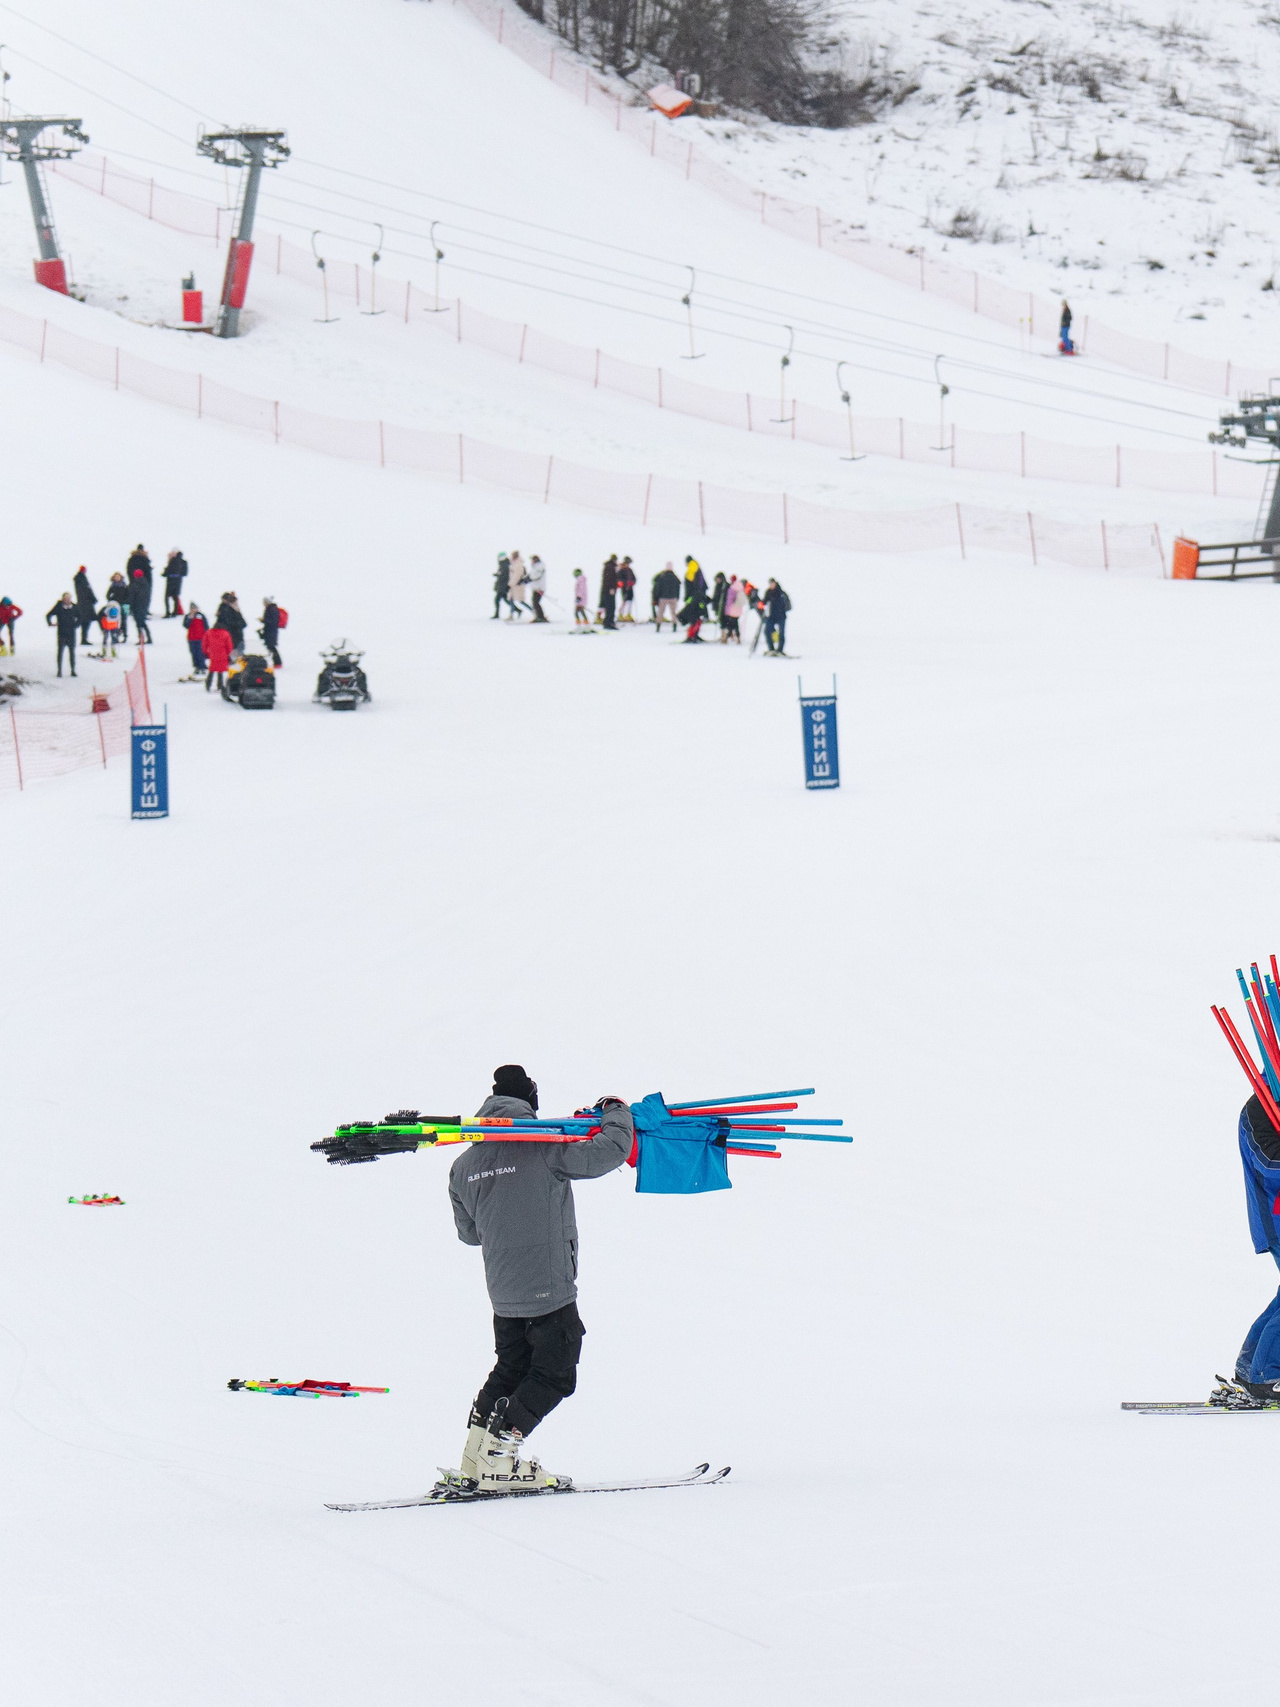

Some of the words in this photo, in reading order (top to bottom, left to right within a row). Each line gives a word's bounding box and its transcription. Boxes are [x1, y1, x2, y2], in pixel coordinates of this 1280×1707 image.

[811, 709, 830, 777] ФИНИШ
[141, 739, 158, 808] ФИНИШ
[467, 1173, 480, 1183] RUS
[495, 1166, 516, 1175] TEAM
[481, 1473, 536, 1482] HEAD
